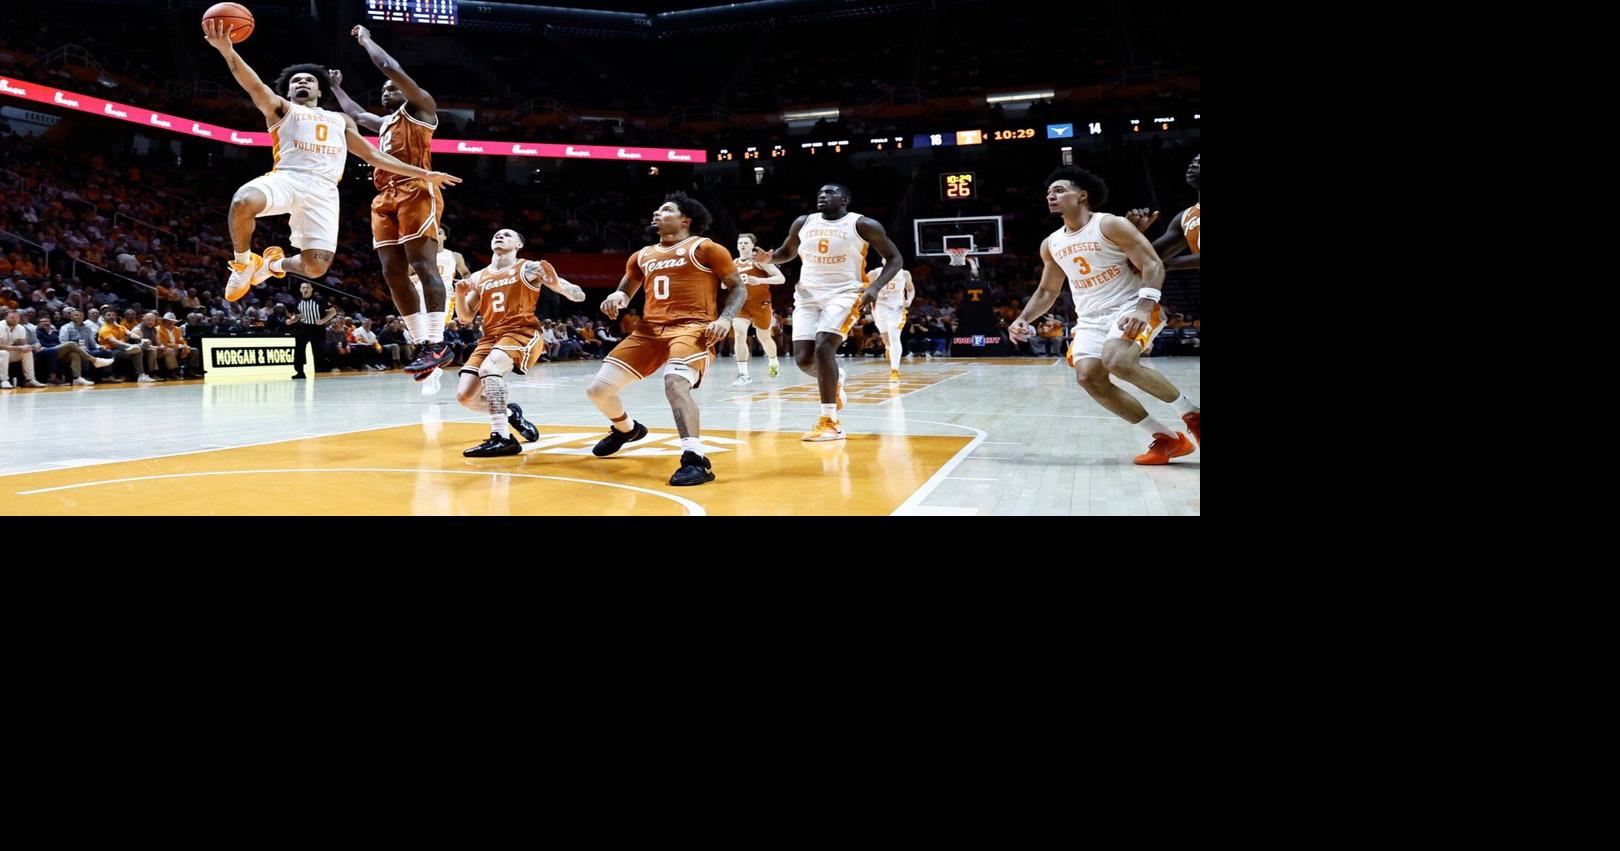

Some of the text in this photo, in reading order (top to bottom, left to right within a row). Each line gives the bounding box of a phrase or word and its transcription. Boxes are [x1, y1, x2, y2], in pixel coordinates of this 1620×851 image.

[314, 123, 329, 141] 0
[994, 129, 1035, 141] 10:29
[1088, 122, 1102, 134] 14
[947, 183, 970, 197] 26
[817, 239, 830, 254] 6
[1056, 241, 1101, 261] TENNESSEE
[640, 257, 687, 277] Texas
[1072, 256, 1092, 275] 3
[479, 276, 517, 295] Texas
[653, 275, 670, 300] 0
[491, 292, 505, 313] 2
[968, 289, 983, 302] T
[216, 349, 257, 365] MORGAN
[258, 349, 266, 364] &
